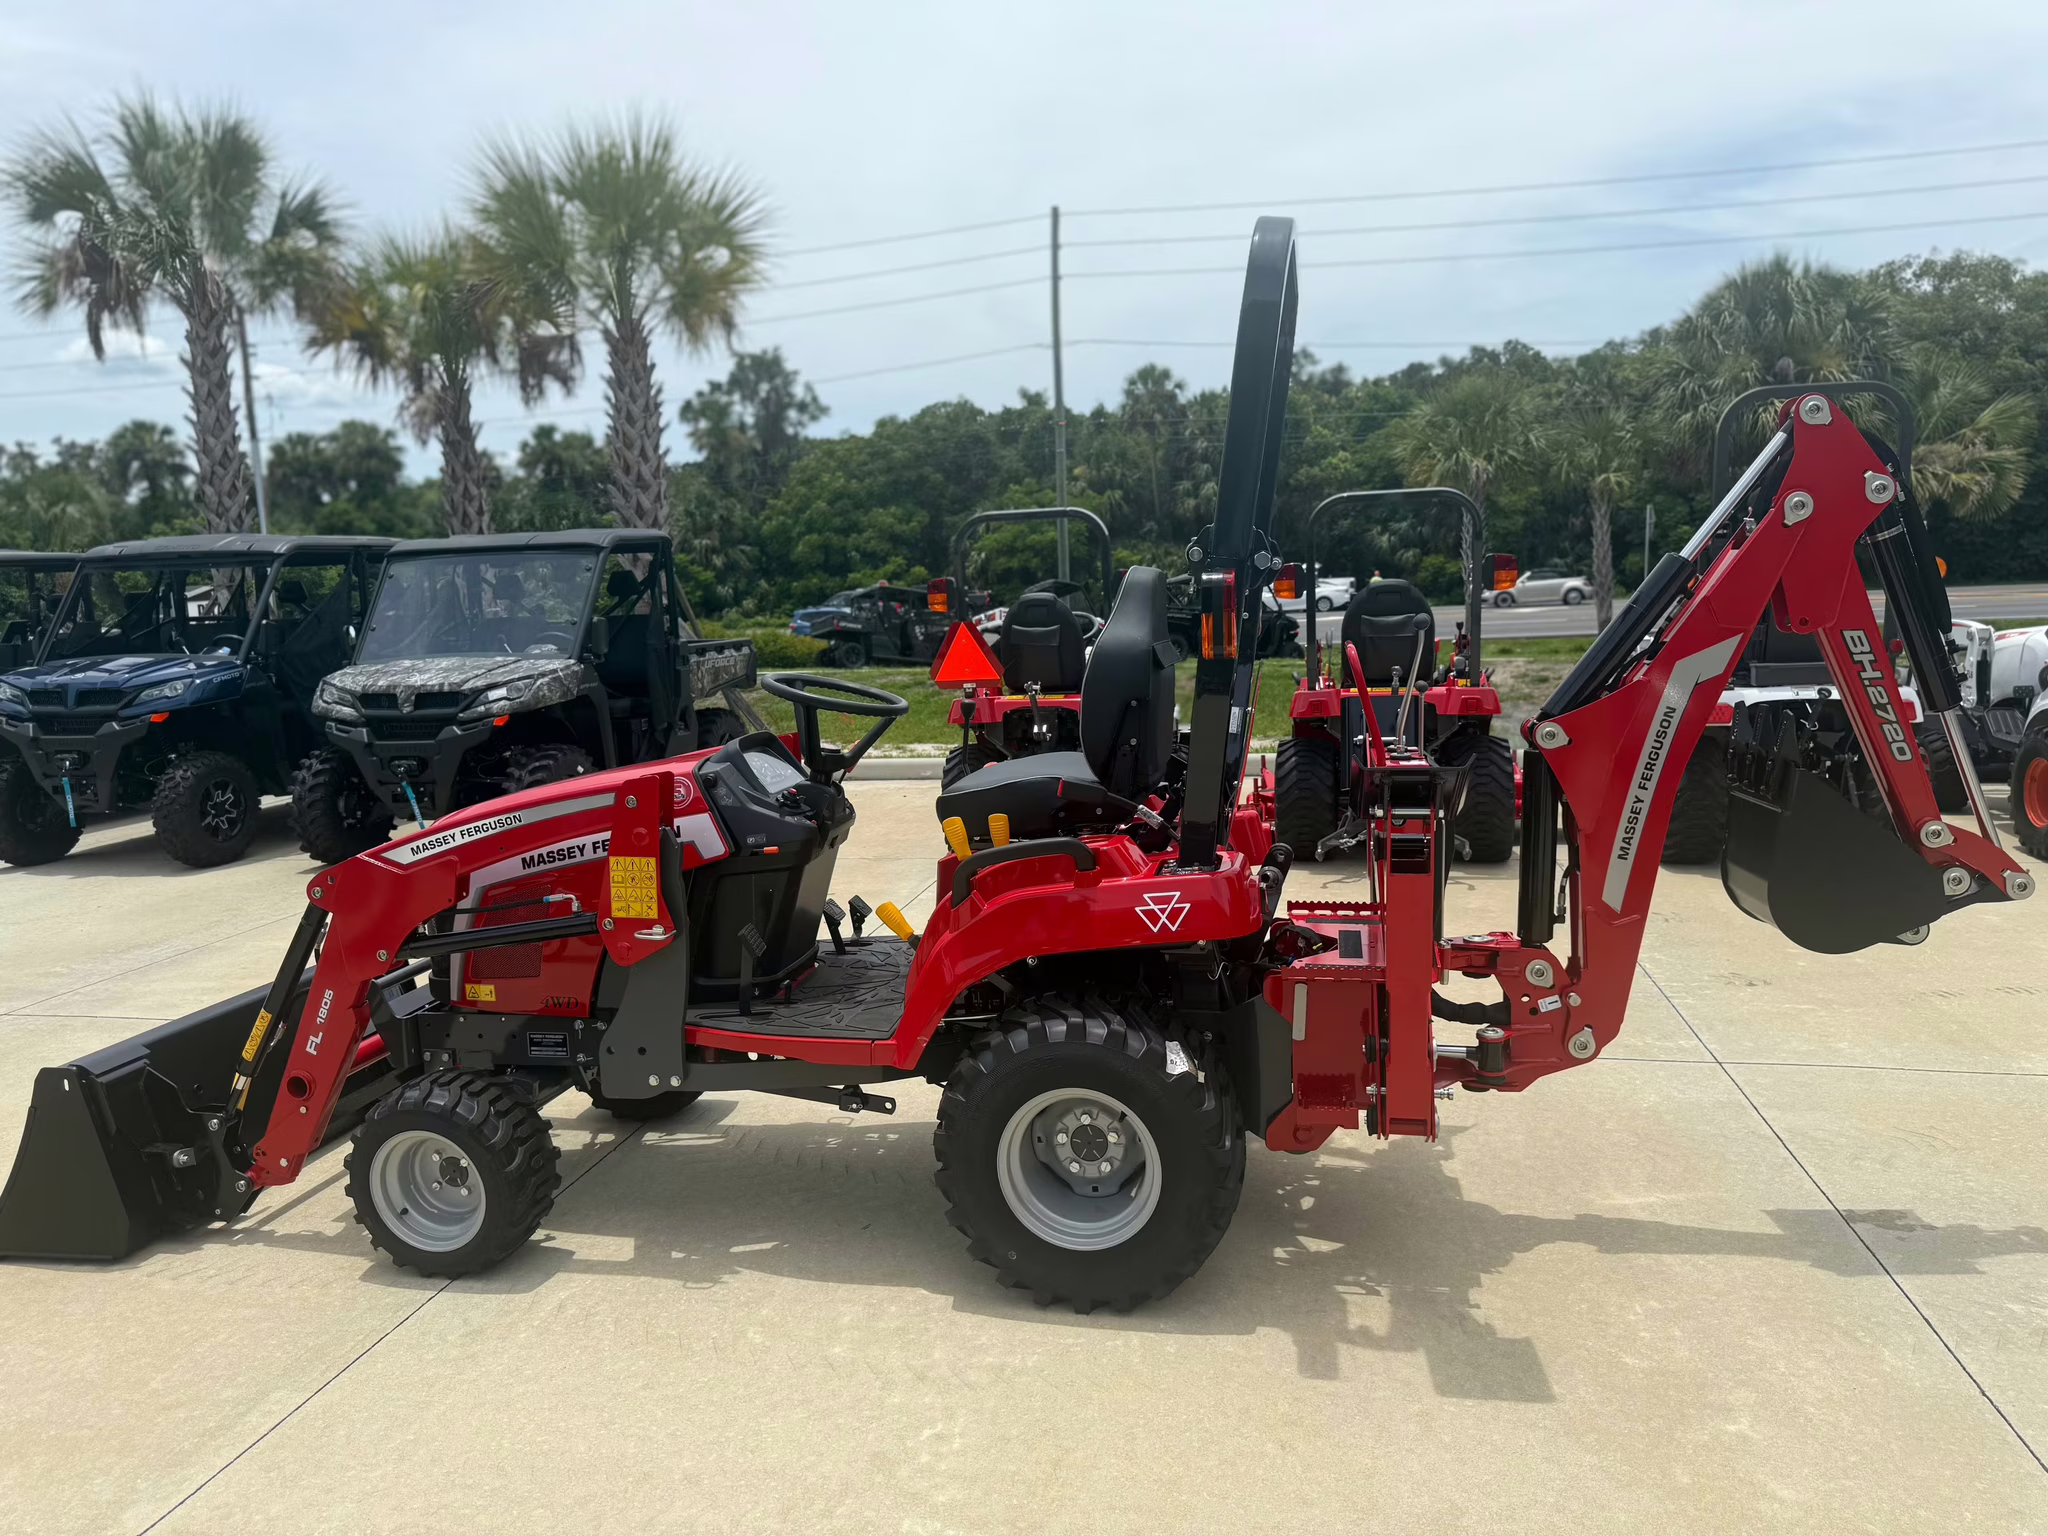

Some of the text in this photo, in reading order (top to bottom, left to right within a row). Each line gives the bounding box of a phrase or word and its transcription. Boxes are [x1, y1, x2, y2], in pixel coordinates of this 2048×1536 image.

[212, 671, 240, 683] CFMOTO
[1841, 629, 1913, 762] BH.2720
[1616, 705, 1677, 861] MASSEY FERGUSON
[410, 813, 523, 857] MASSEY FERGUSON
[520, 843, 586, 871] MASSEY
[305, 988, 334, 1056] FL 1805
[540, 996, 580, 1010] 4WD
